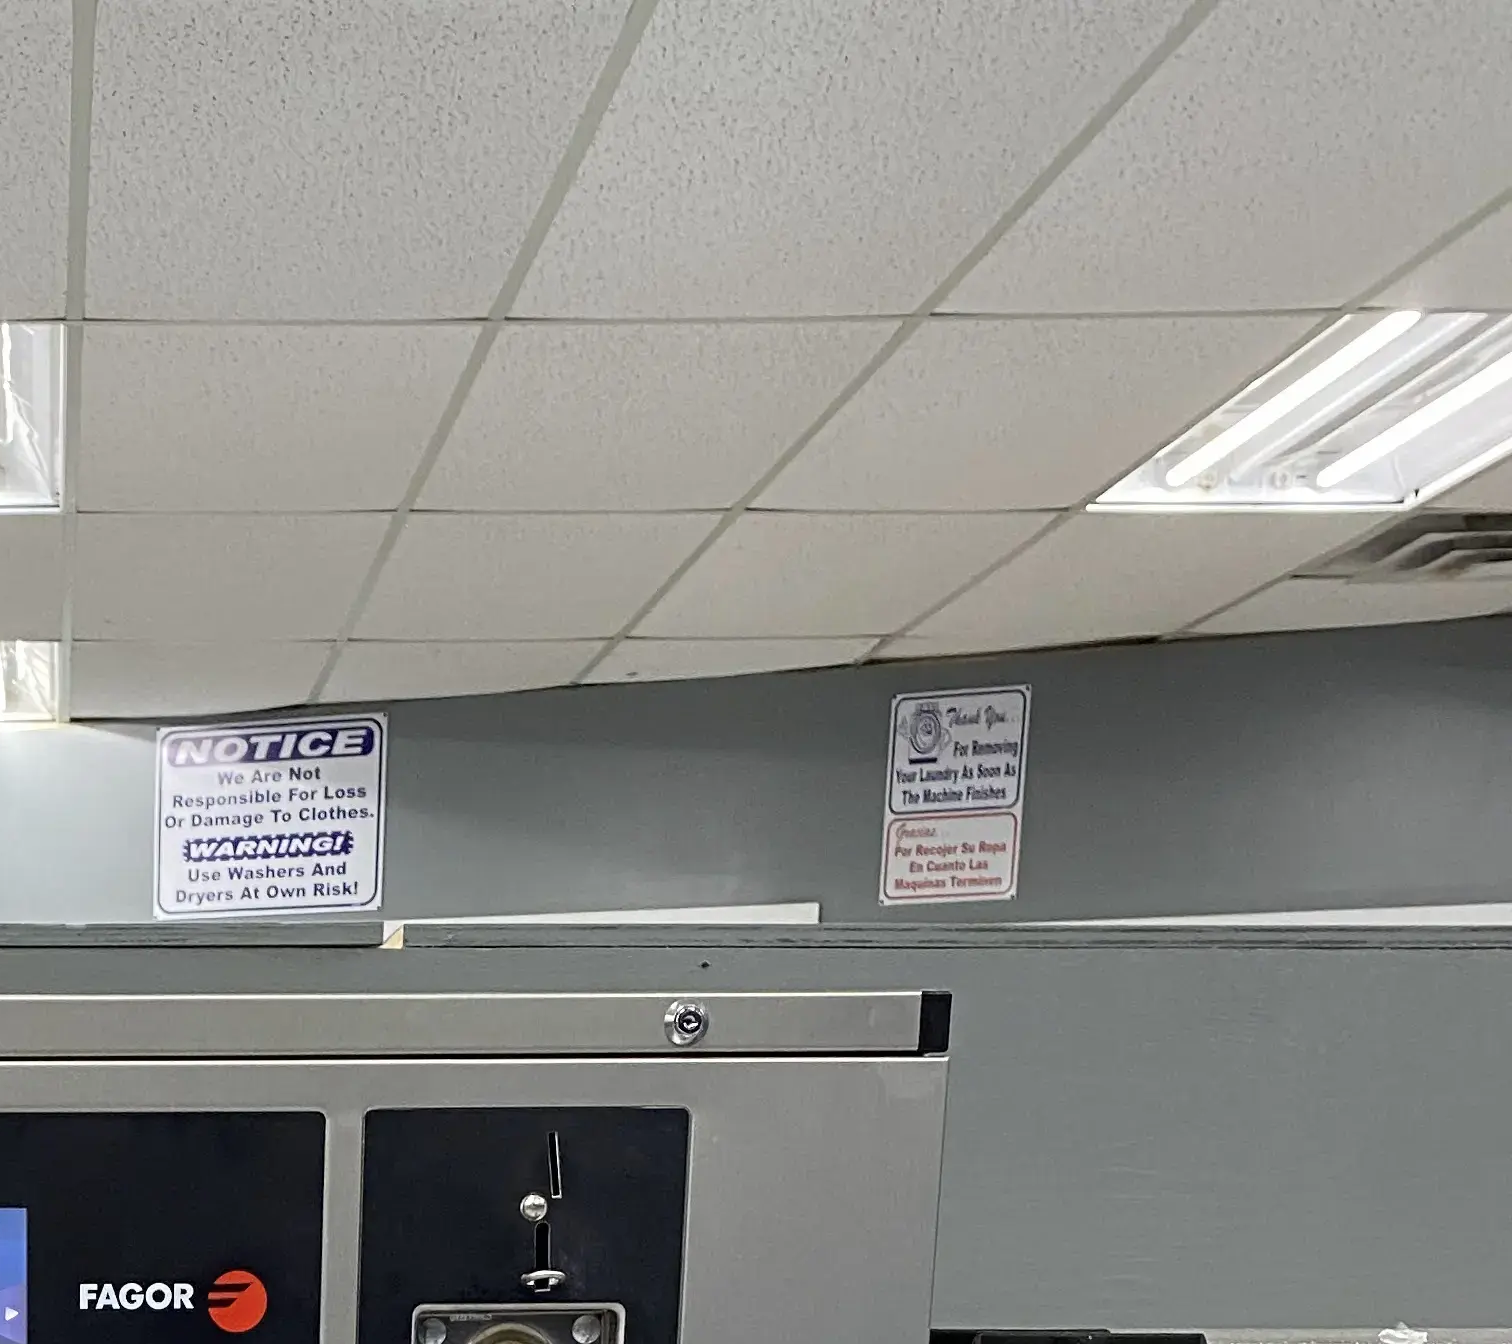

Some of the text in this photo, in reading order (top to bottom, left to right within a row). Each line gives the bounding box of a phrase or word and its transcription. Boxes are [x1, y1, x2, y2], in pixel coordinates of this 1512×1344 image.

[175, 729, 367, 765] NOTICE
[953, 741, 968, 757] For
[218, 766, 321, 785] We Are Not
[920, 766, 959, 784] Laundry
[962, 765, 974, 779] As
[978, 764, 1001, 779] Soon
[1004, 762, 1016, 777] As
[173, 786, 366, 809] Responsible For Loss
[165, 806, 375, 829] Or Damage To Clothes.
[189, 835, 345, 859] WARNING!
[188, 861, 347, 882] Use Washers And
[176, 881, 359, 906] Dryers At Own Risk!
[79, 1282, 194, 1310] FAGOR
